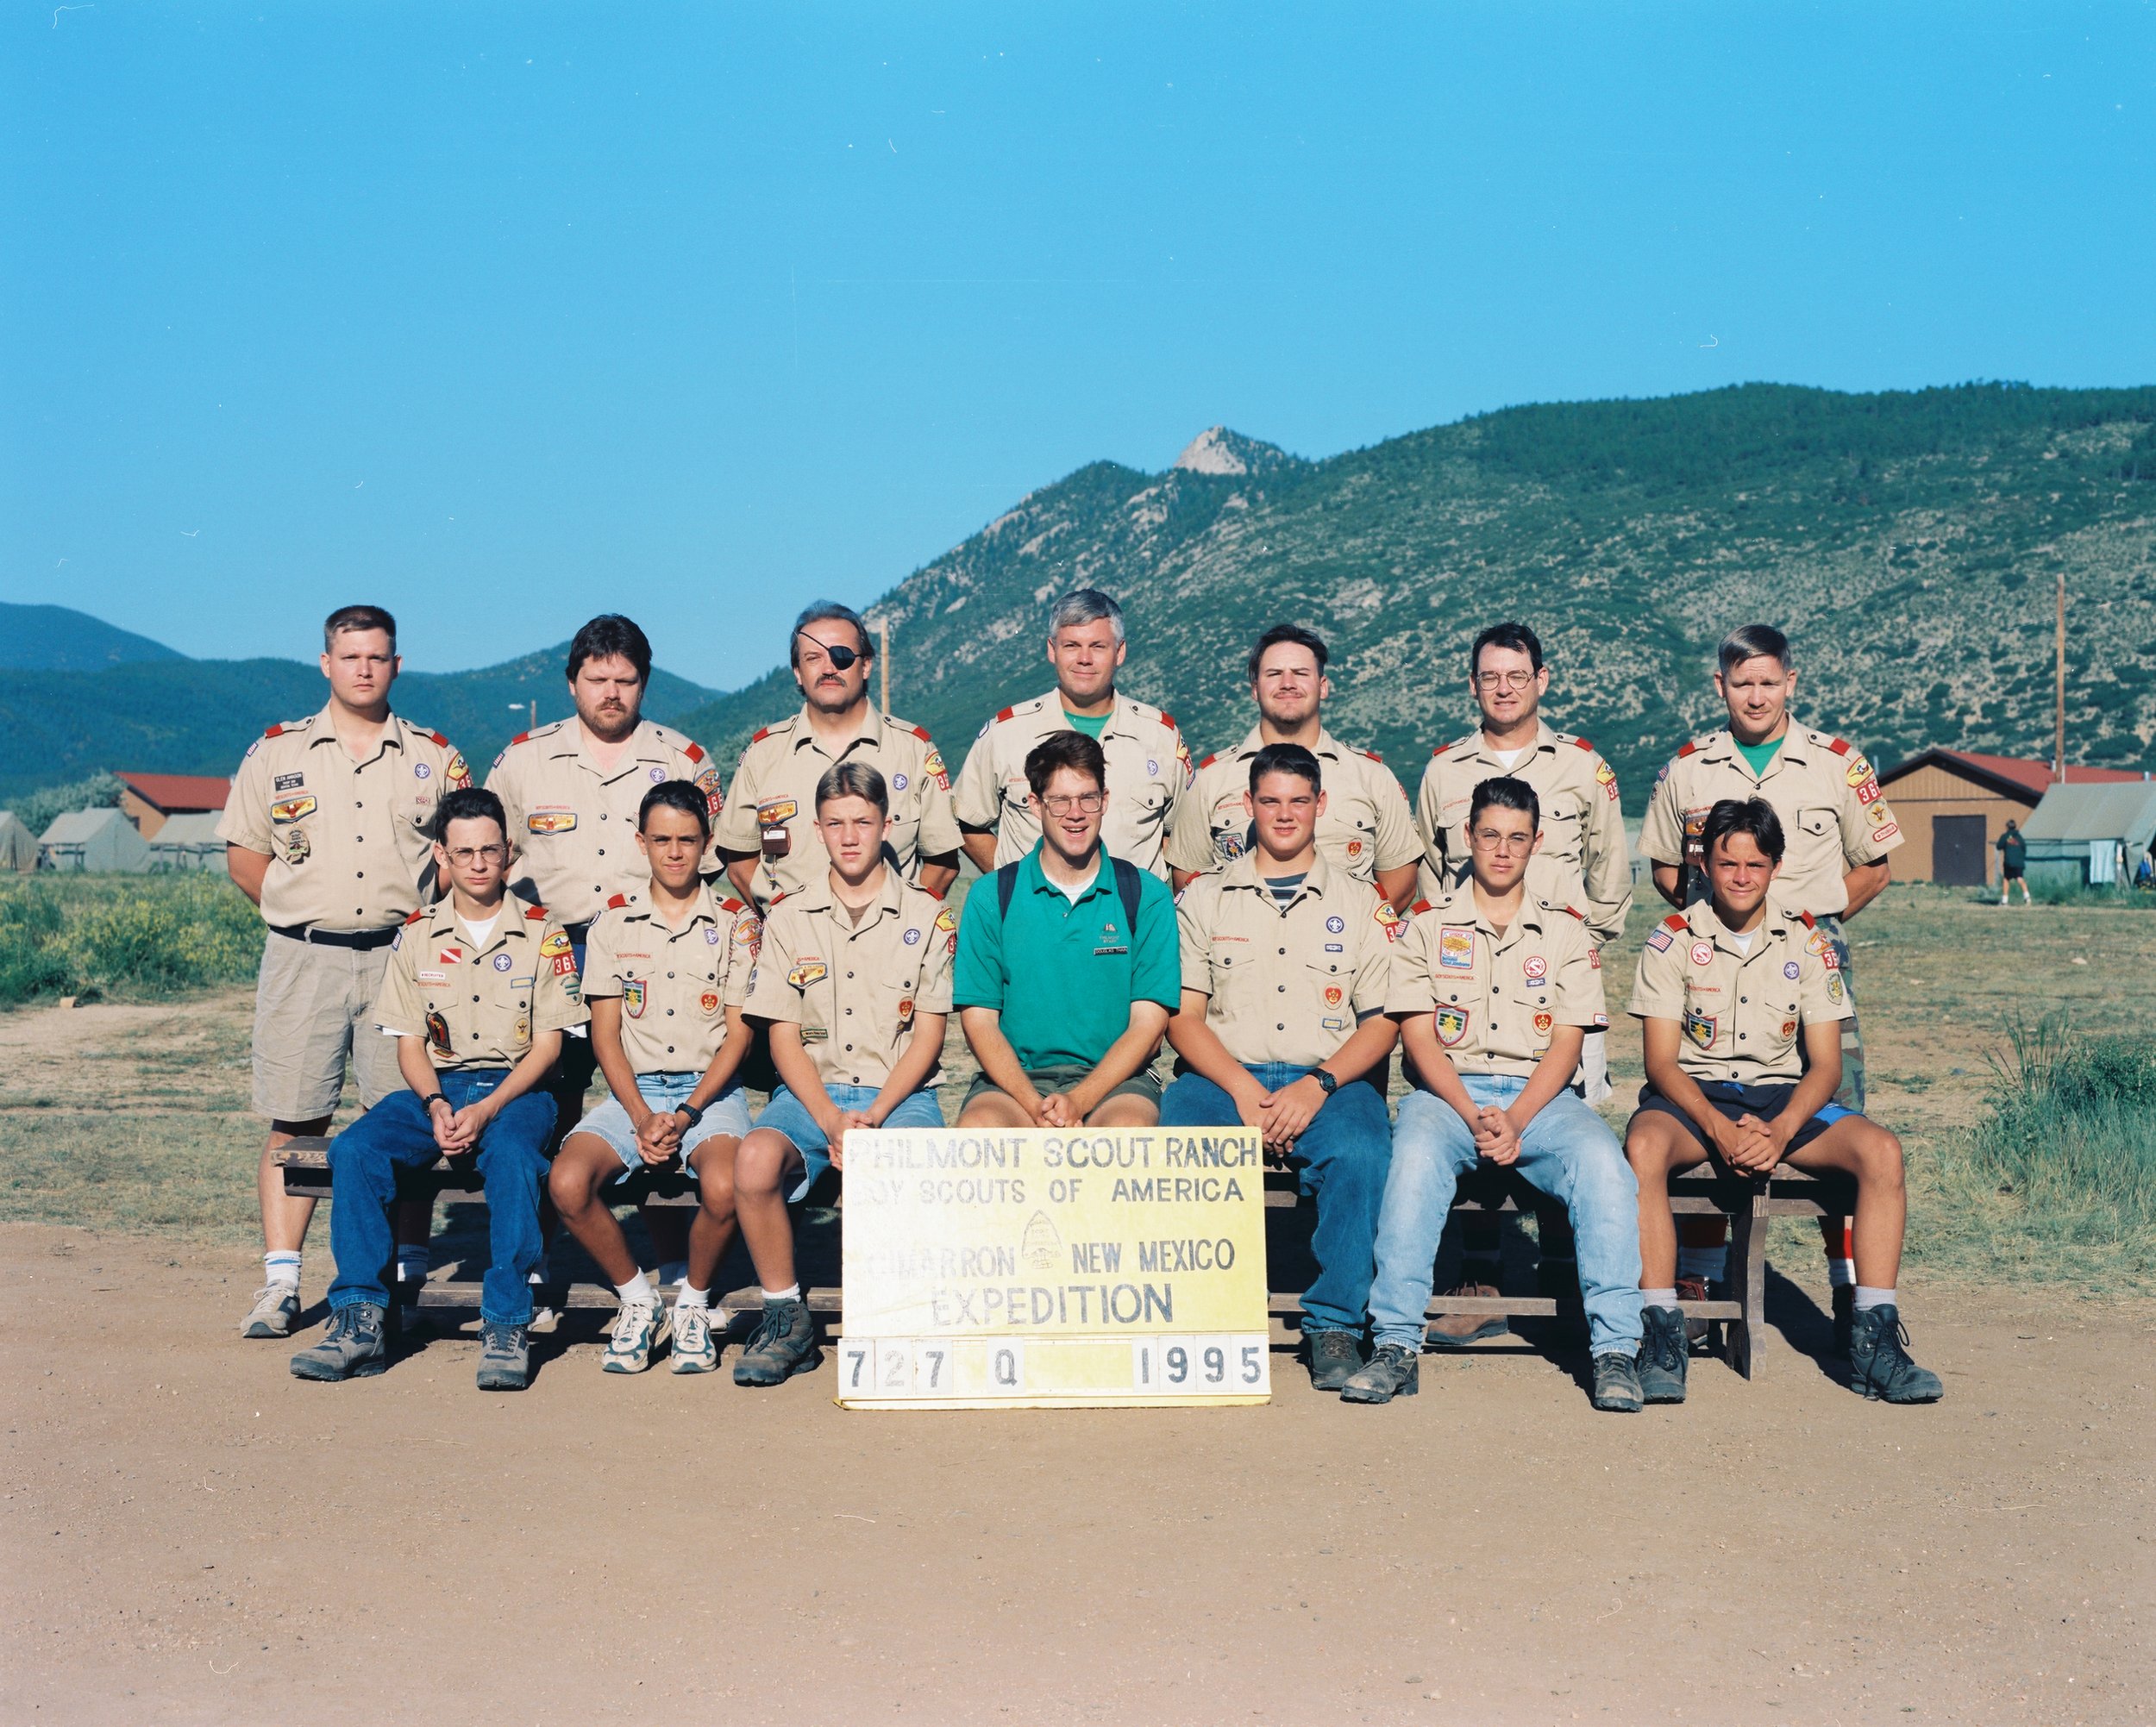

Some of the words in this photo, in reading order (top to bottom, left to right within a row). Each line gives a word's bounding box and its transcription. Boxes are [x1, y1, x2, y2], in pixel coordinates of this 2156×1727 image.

[849, 1137, 1028, 1168] PHILMONT
[1043, 1137, 1155, 1168] SCOUT
[1165, 1137, 1257, 1168] RANCH
[919, 1179, 1026, 1205] SCOUTS
[1049, 1179, 1083, 1204] OF
[1111, 1177, 1245, 1203] AMERICA
[1071, 1242, 1122, 1274] NEW
[1138, 1238, 1235, 1273] MEXICO
[931, 1283, 1174, 1326] EXPEDITION
[994, 1348, 1018, 1386] Q
[1141, 1346, 1262, 1384] 1995
